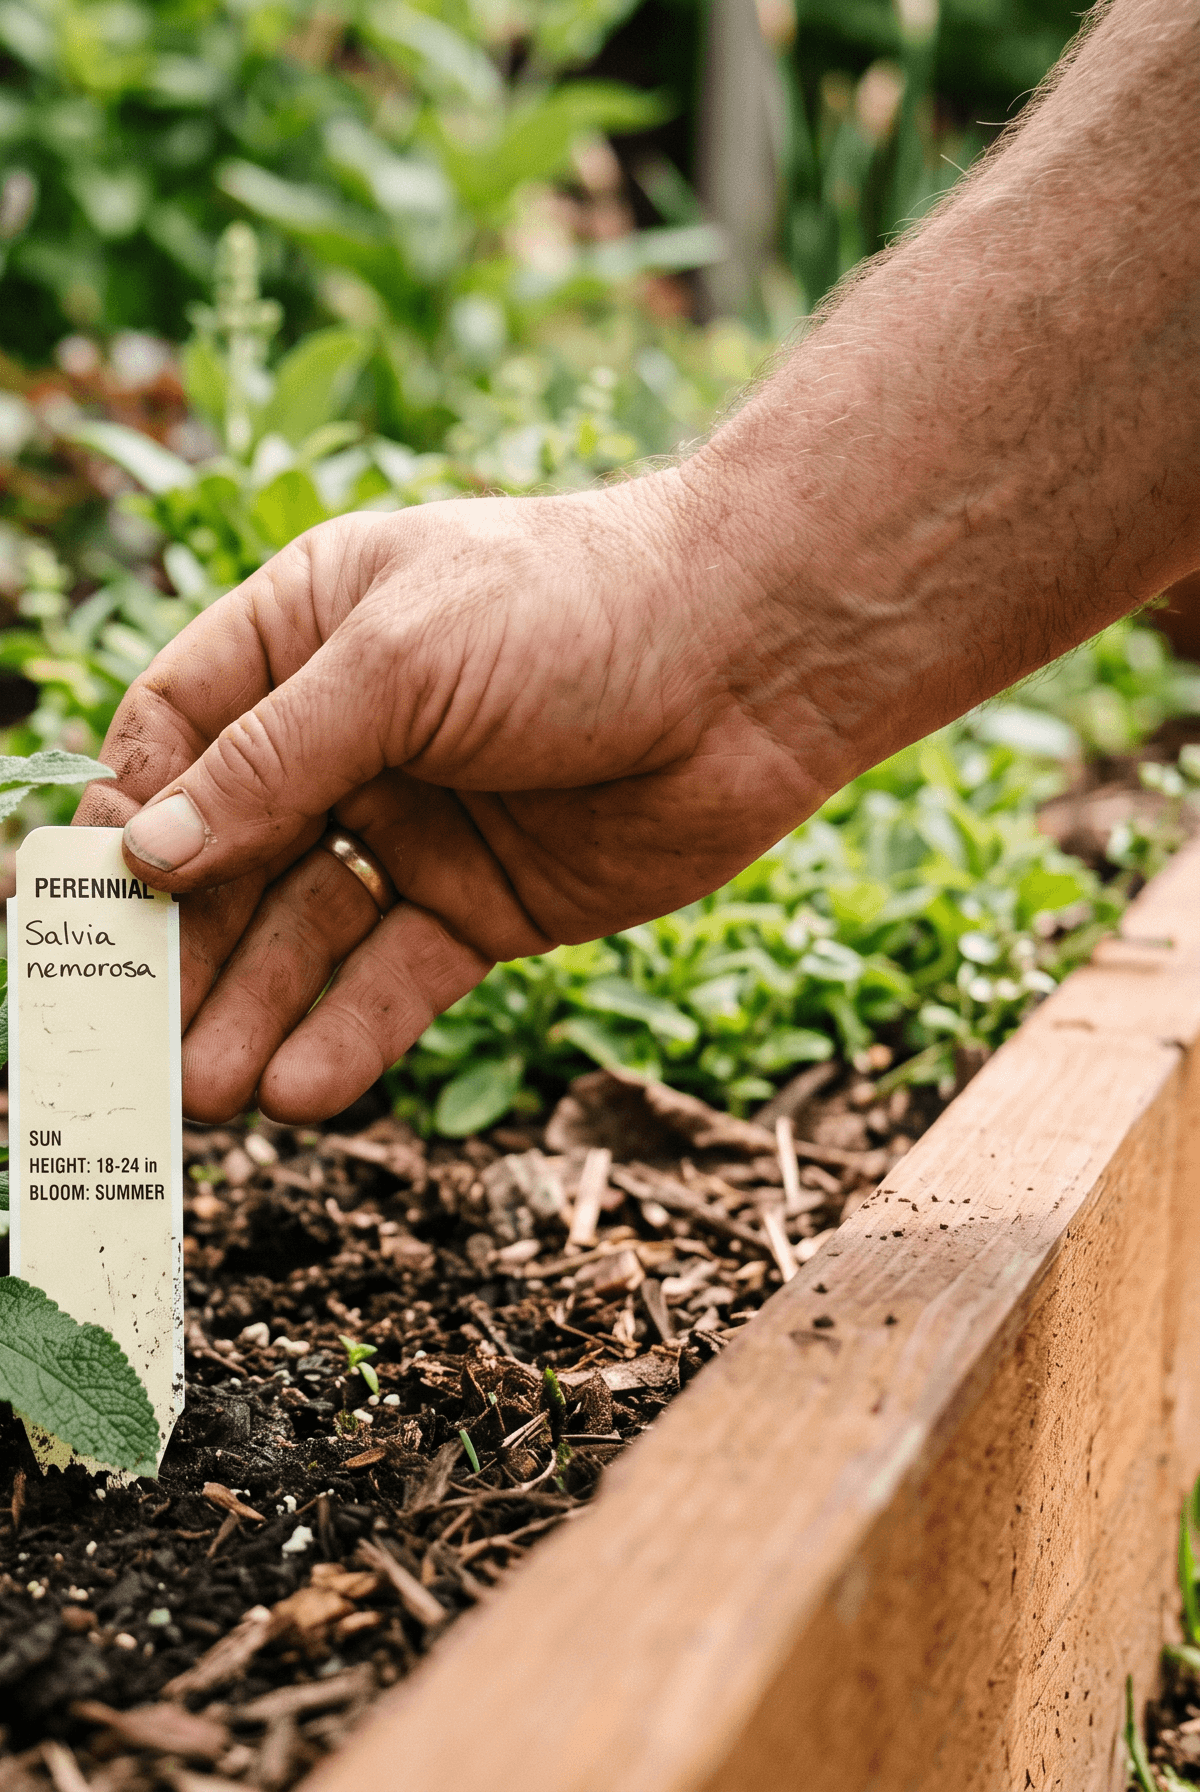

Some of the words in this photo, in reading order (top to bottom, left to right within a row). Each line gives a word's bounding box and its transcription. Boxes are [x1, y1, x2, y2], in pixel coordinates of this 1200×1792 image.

[35, 877, 155, 899] PERENNIAL
[25, 919, 116, 946] Salvia
[27, 960, 157, 979] nemorosa
[29, 1130, 62, 1147] SUN
[29, 1157, 91, 1174] HEIGHT:
[96, 1157, 140, 1174] 18-24
[144, 1157, 158, 1173] in
[29, 1184, 90, 1201] BLOOM:
[95, 1184, 165, 1201] SUMMER
